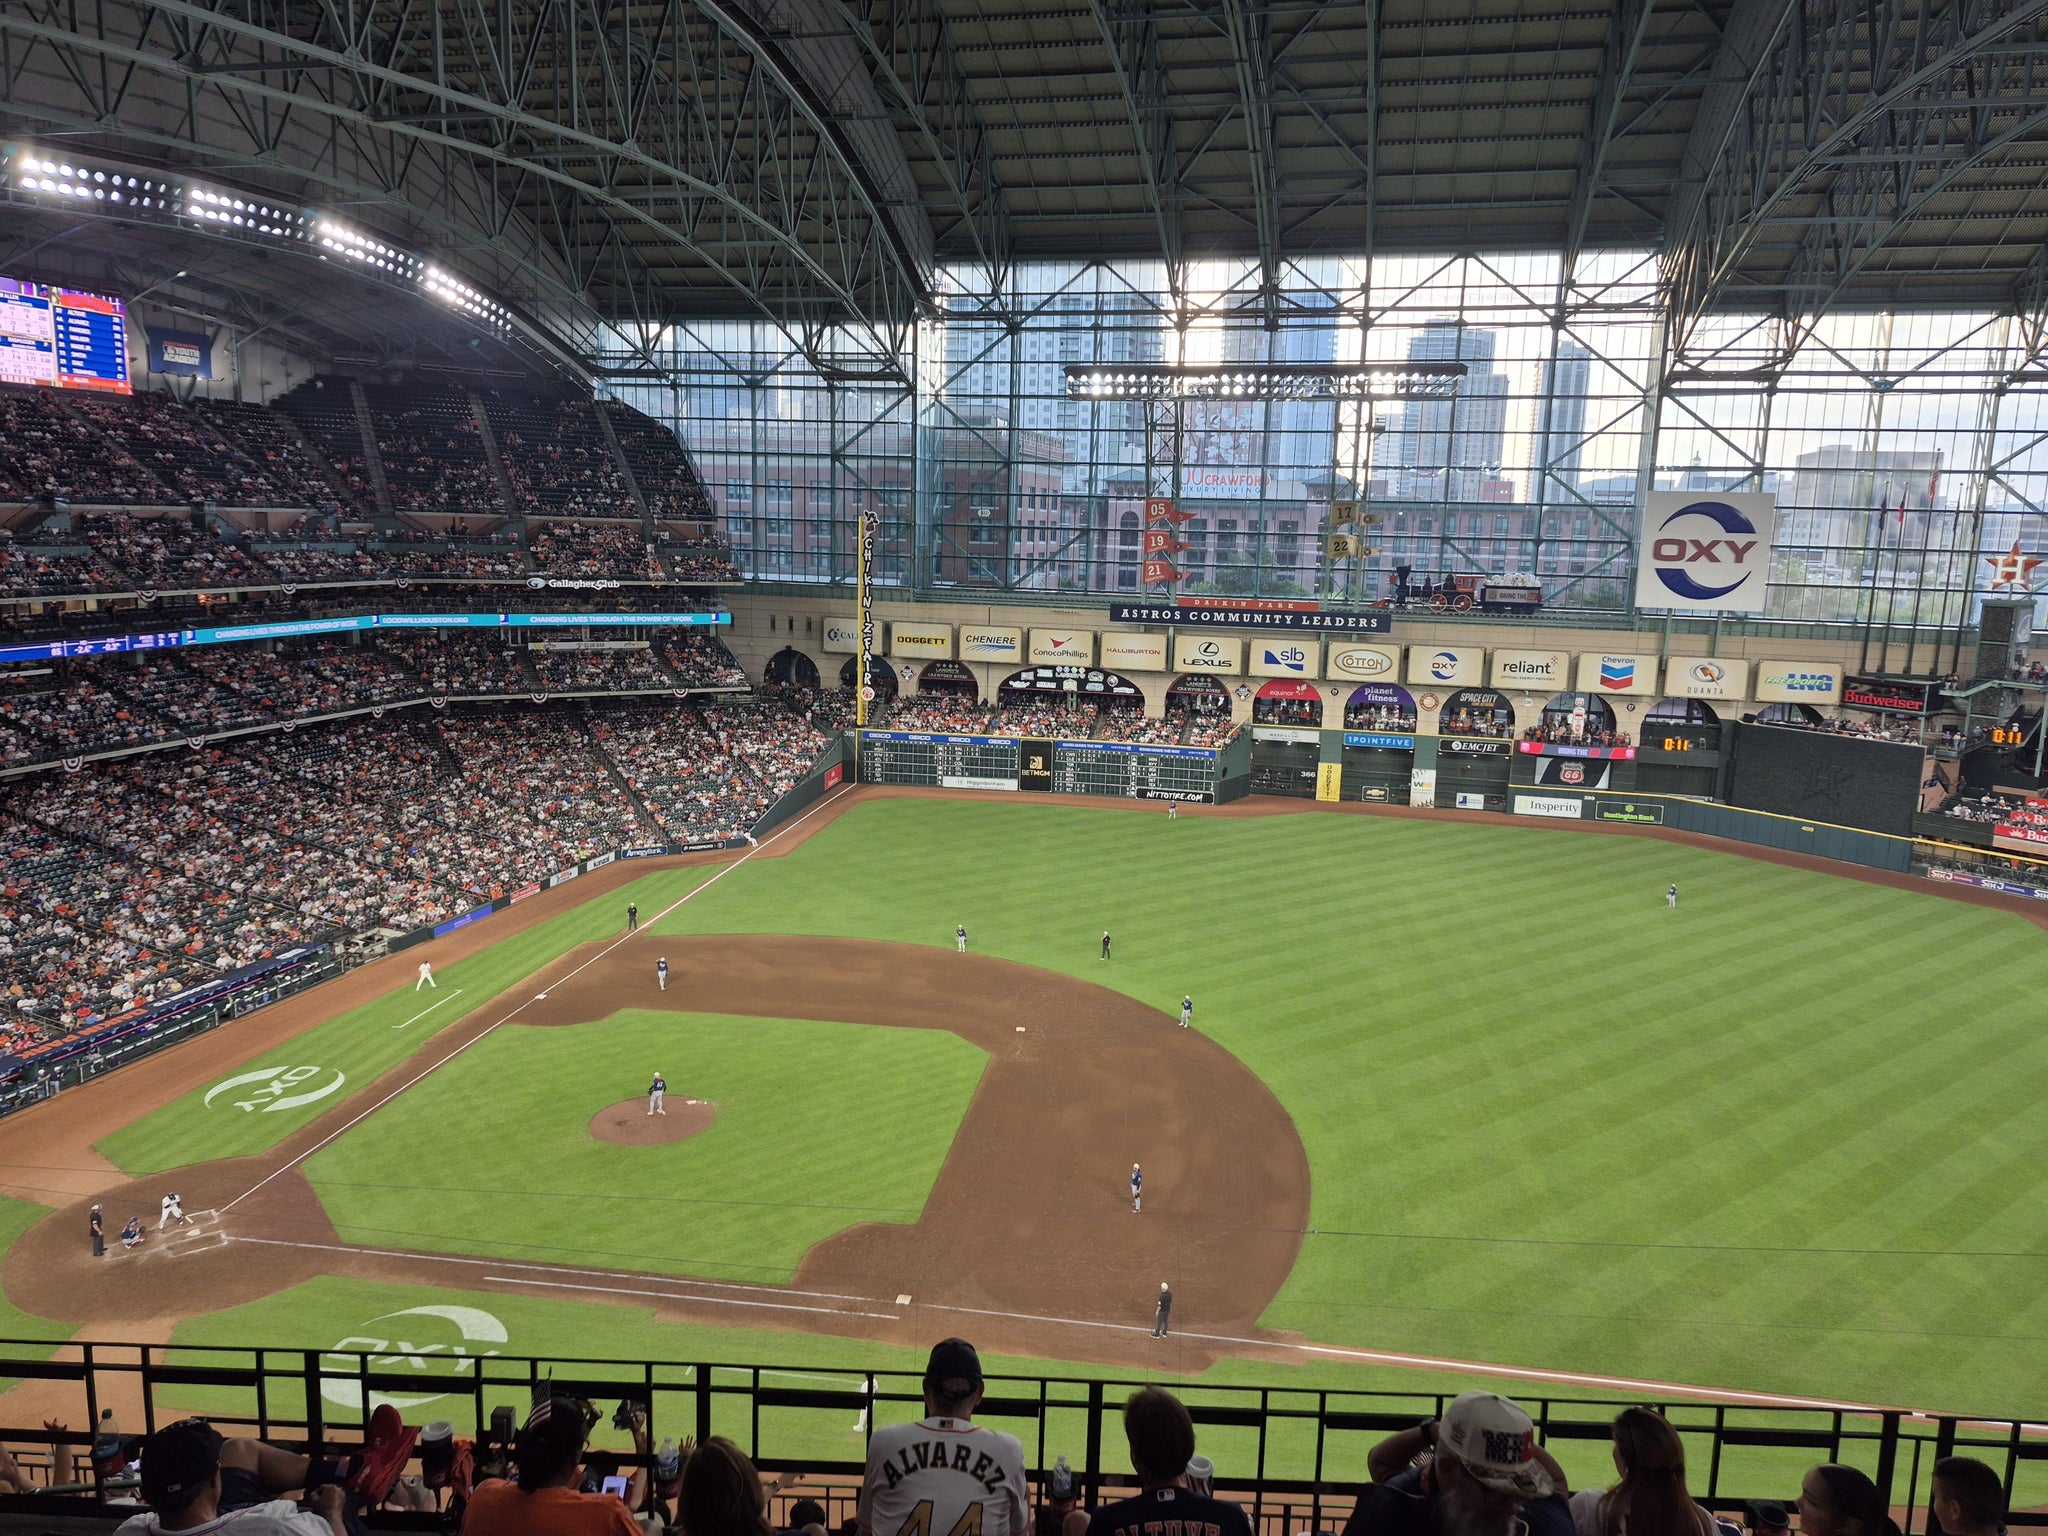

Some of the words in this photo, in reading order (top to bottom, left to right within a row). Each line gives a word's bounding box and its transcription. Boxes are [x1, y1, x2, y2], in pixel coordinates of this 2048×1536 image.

[176, 347, 199, 357] YOUTH
[163, 354, 200, 365] ACADEMY
[1181, 486, 1216, 494] UXURY
[1150, 503, 1166, 516] 05
[1337, 507, 1351, 519] 17
[1150, 536, 1165, 546] 19
[1333, 541, 1348, 551] 22
[1653, 538, 1758, 563] OXY
[863, 538, 873, 609] CHIKIN
[1148, 565, 1162, 576] 21
[548, 579, 596, 589] Gallagher
[1194, 598, 1247, 609] DAIKIN
[1121, 608, 1182, 620] ASTROS
[1189, 611, 1294, 625] COMMUNITY
[1302, 615, 1379, 628] LEADERS
[897, 636, 946, 646] DOGGETT
[966, 635, 1017, 645] CHENIERE
[1033, 649, 1088, 659] ConocoPhillips
[1106, 647, 1160, 655] HALLIBURTON
[1280, 647, 1305, 661] slb
[1183, 658, 1232, 667] LEXUS
[1342, 655, 1384, 670] COTTON
[1602, 656, 1635, 664] Chevron
[1503, 660, 1551, 674] reliant
[1764, 677, 1825, 686] FREEPORT
[1787, 673, 1833, 692] LNG
[1364, 687, 1393, 695] planet
[1687, 687, 1724, 695] QUANTA
[1367, 693, 1398, 702] fitness
[1460, 692, 1482, 702] SPACE
[1482, 693, 1498, 703] CITY
[1845, 690, 1923, 710] Budweiser
[1348, 736, 1410, 746] 1POINTFIVE
[1993, 728, 2023, 744] 0:11
[1462, 743, 1499, 752] EMCJET
[1664, 738, 1690, 751] 0:11
[1563, 771, 1580, 779] 66
[1146, 790, 1204, 802] NITTOTIRE.COM
[1530, 801, 1580, 813] Insperity
[1603, 812, 1638, 821] Huntington
[1638, 813, 1655, 821] Bank
[233, 1065, 321, 1113] OXY
[326, 1336, 500, 1373] OXY
[882, 1440, 1008, 1497] ALVAREZ
